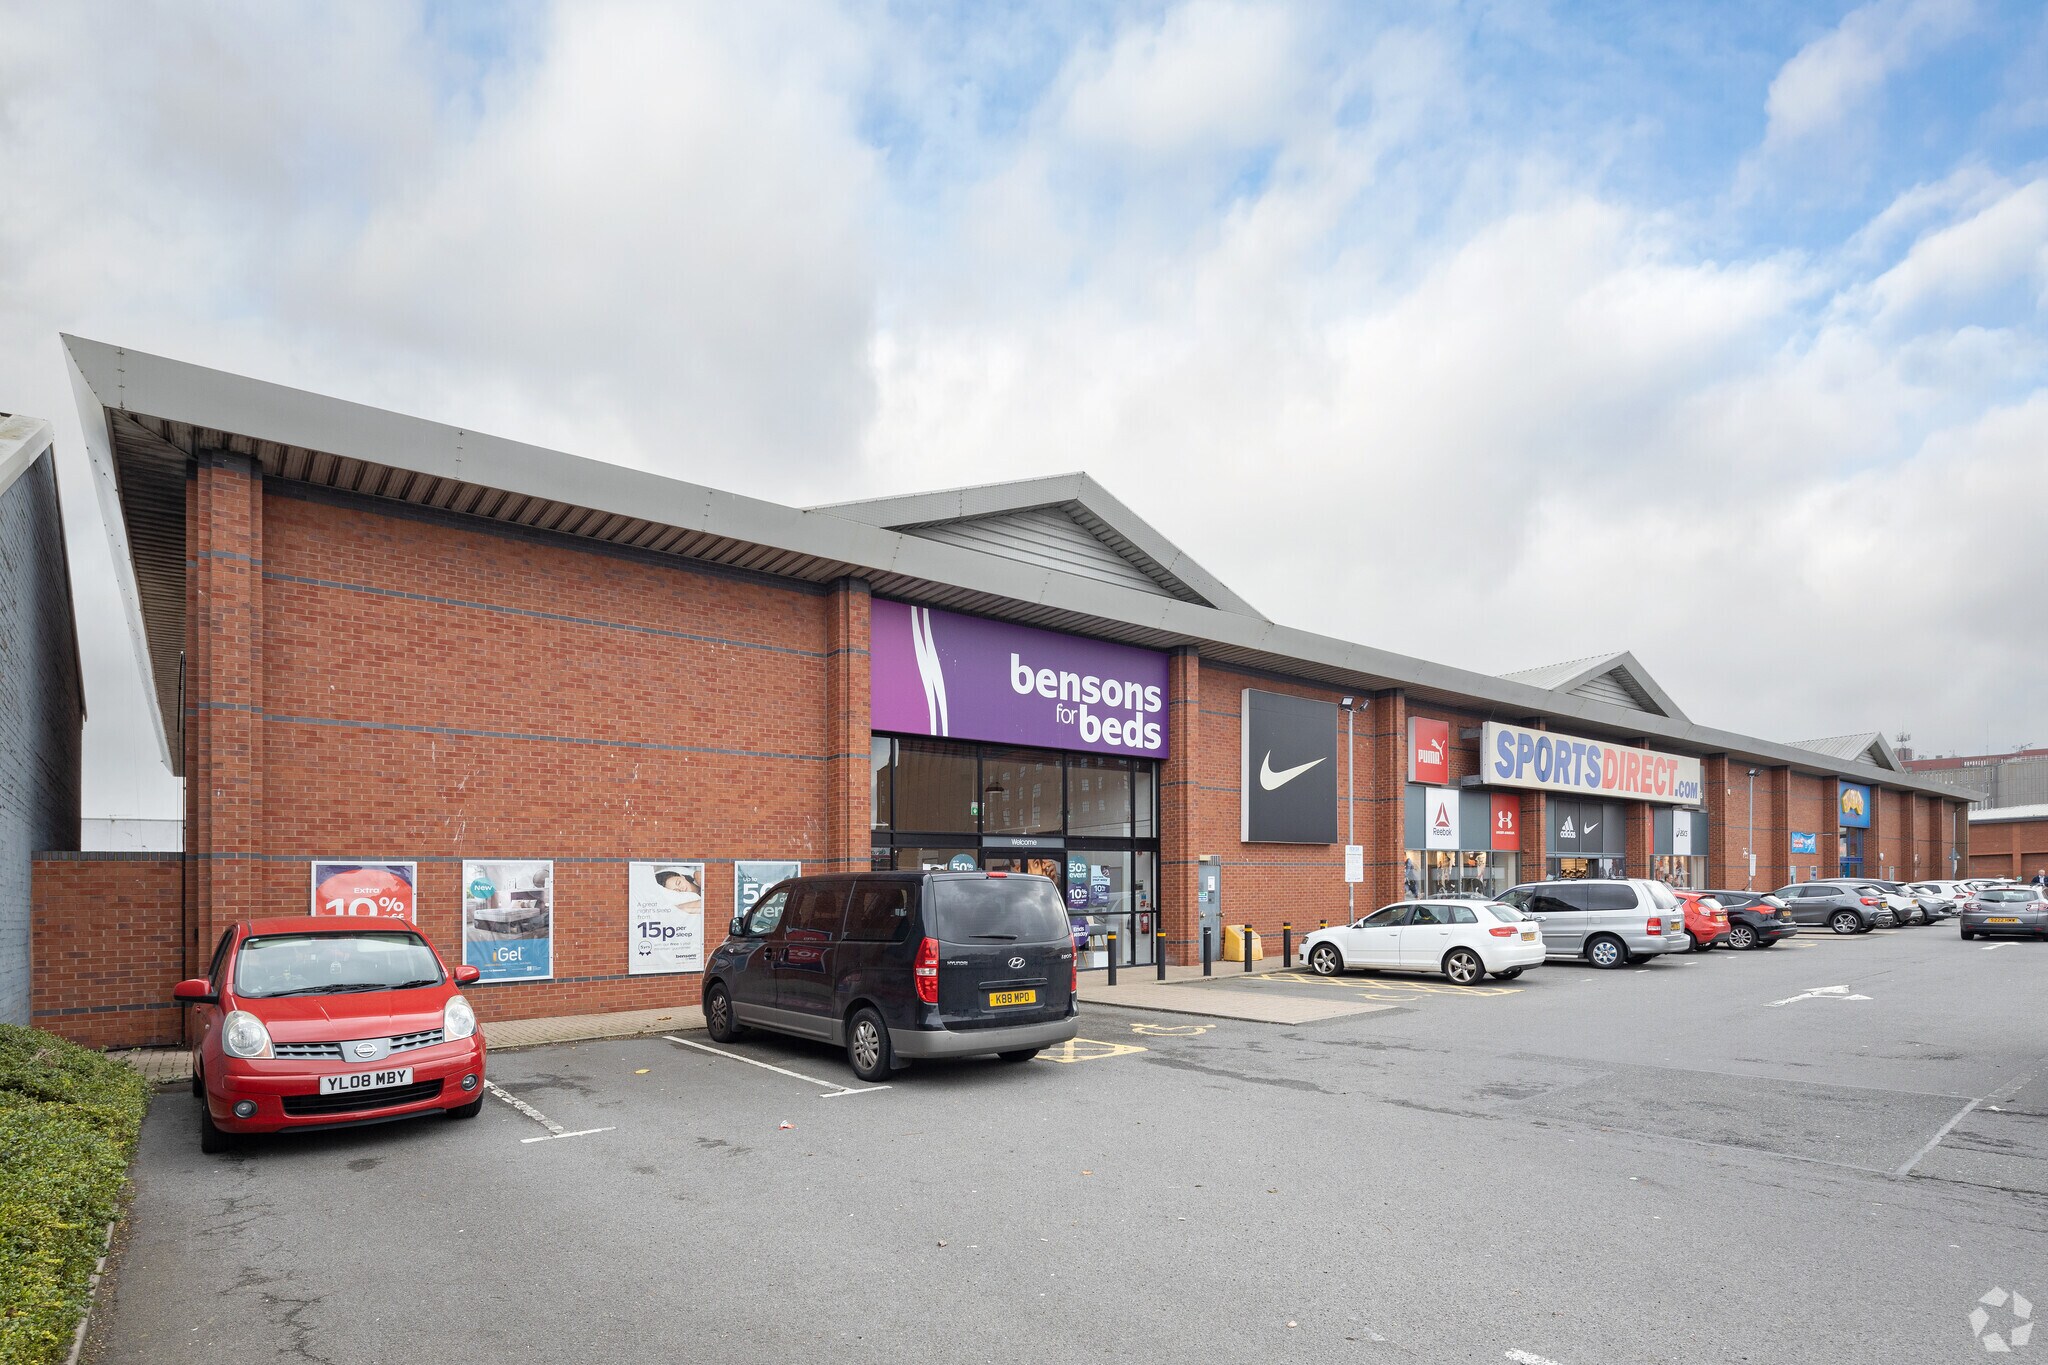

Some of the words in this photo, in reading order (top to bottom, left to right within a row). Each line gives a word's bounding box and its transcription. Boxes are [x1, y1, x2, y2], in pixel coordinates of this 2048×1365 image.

[1010, 652, 1162, 713] bensons
[1056, 703, 1078, 725] for
[1079, 704, 1162, 750] beds
[1418, 749, 1440, 765] PUMA
[1494, 729, 1698, 799] SPORTSDIRECT.COM
[1010, 838, 1038, 846] Welcome
[1432, 827, 1452, 837] Reebok
[637, 921, 676, 941] 15p
[995, 993, 1013, 1004] K88
[328, 1074, 371, 1091] YL08
[375, 1069, 407, 1086] MBY
